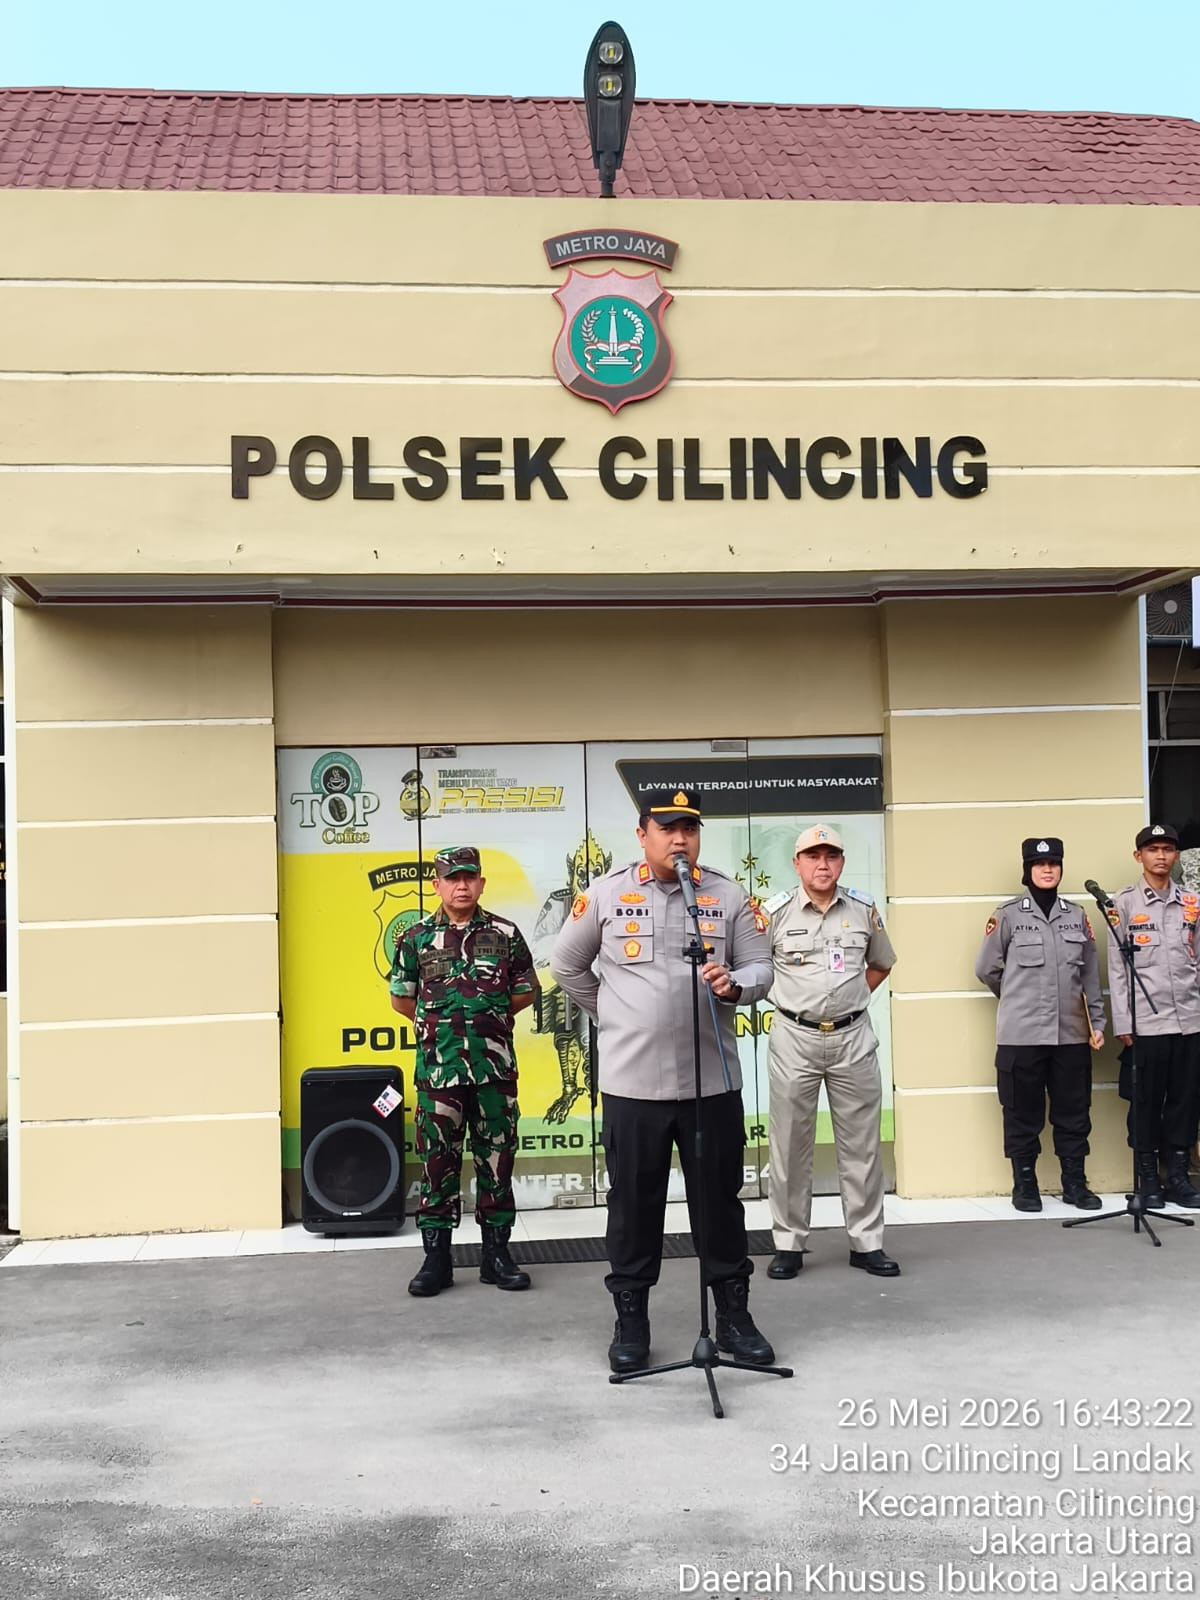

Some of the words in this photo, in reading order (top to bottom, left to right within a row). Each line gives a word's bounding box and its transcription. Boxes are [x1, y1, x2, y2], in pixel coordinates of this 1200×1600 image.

[555, 235, 619, 257] METRO
[624, 237, 666, 259] JAYA
[231, 436, 568, 500] POLSEK
[599, 436, 988, 500] CILINCING
[638, 782, 694, 791] LAYANAN
[696, 781, 752, 791] TERPADU
[754, 779, 795, 788] UNTUK
[797, 777, 879, 787] MASYARAKAT
[440, 786, 564, 807] PRESISI
[290, 791, 380, 828] TOP
[322, 827, 371, 845] Coffee
[375, 867, 418, 885] METRO
[423, 867, 438, 878] JA
[616, 908, 649, 917] BOBI
[689, 908, 723, 918] OLRI
